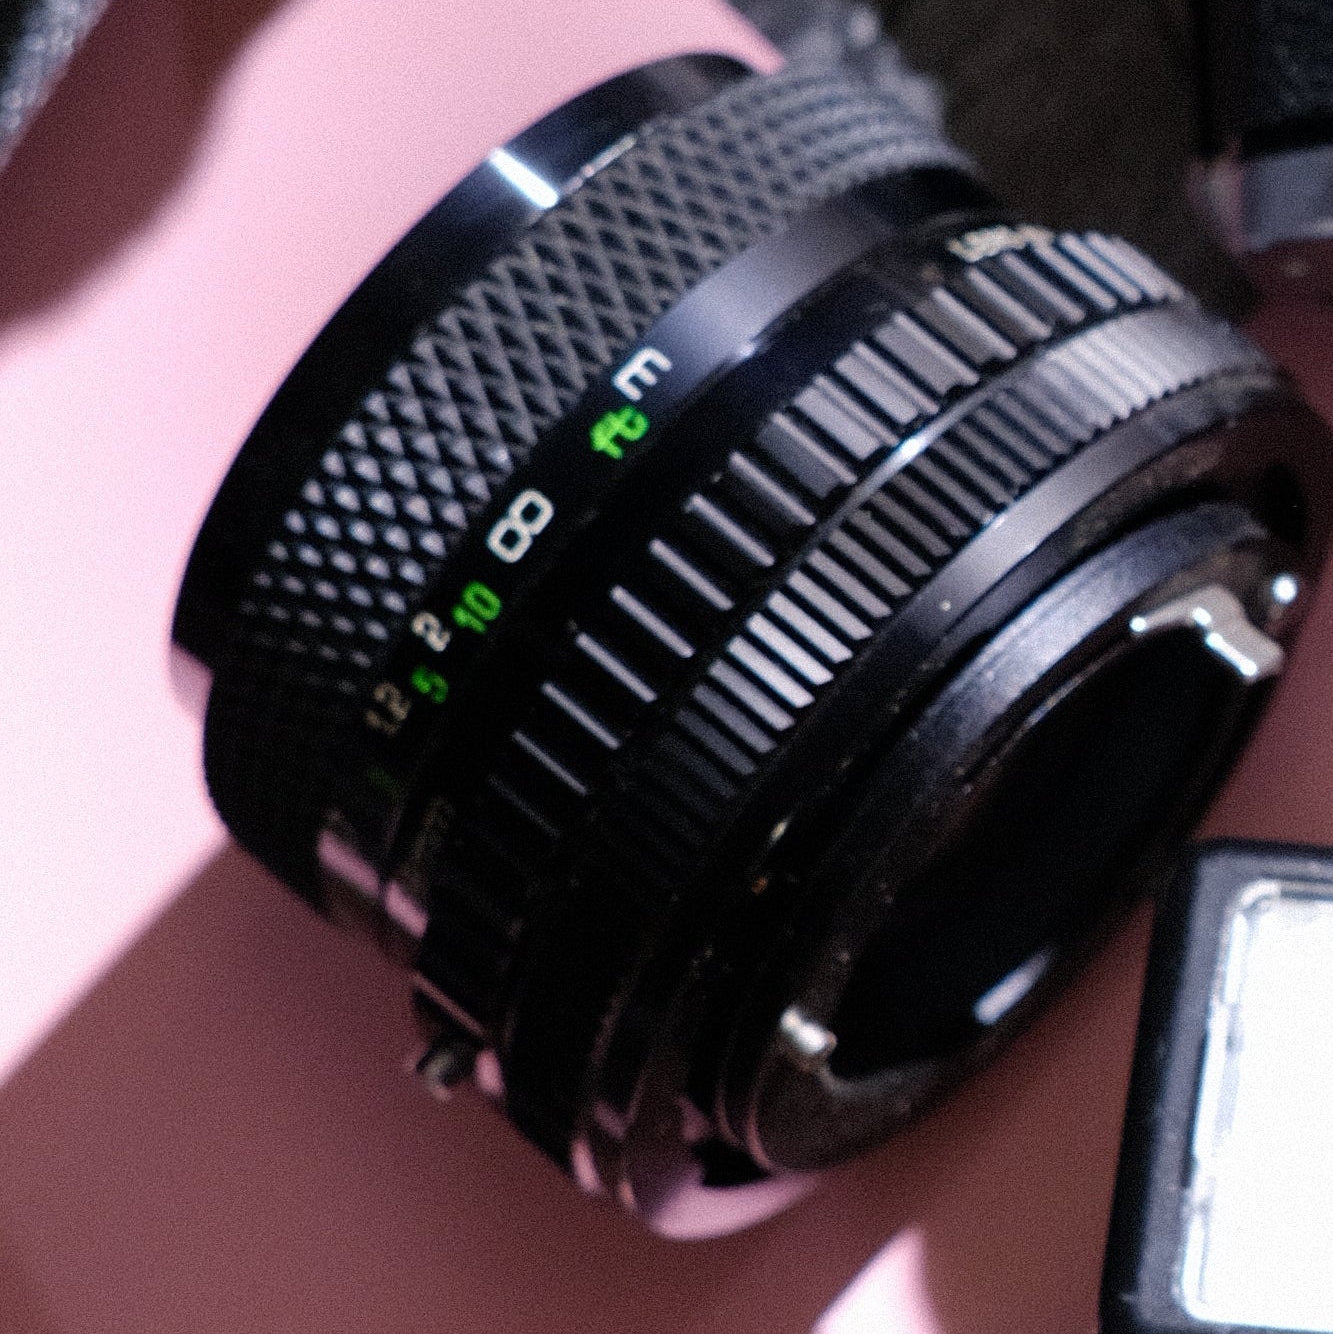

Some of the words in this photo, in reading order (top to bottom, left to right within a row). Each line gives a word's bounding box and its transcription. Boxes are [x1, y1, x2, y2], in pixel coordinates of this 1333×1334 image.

[613, 347, 672, 401] m
[411, 611, 451, 654] 2
[452, 581, 502, 634] 10
